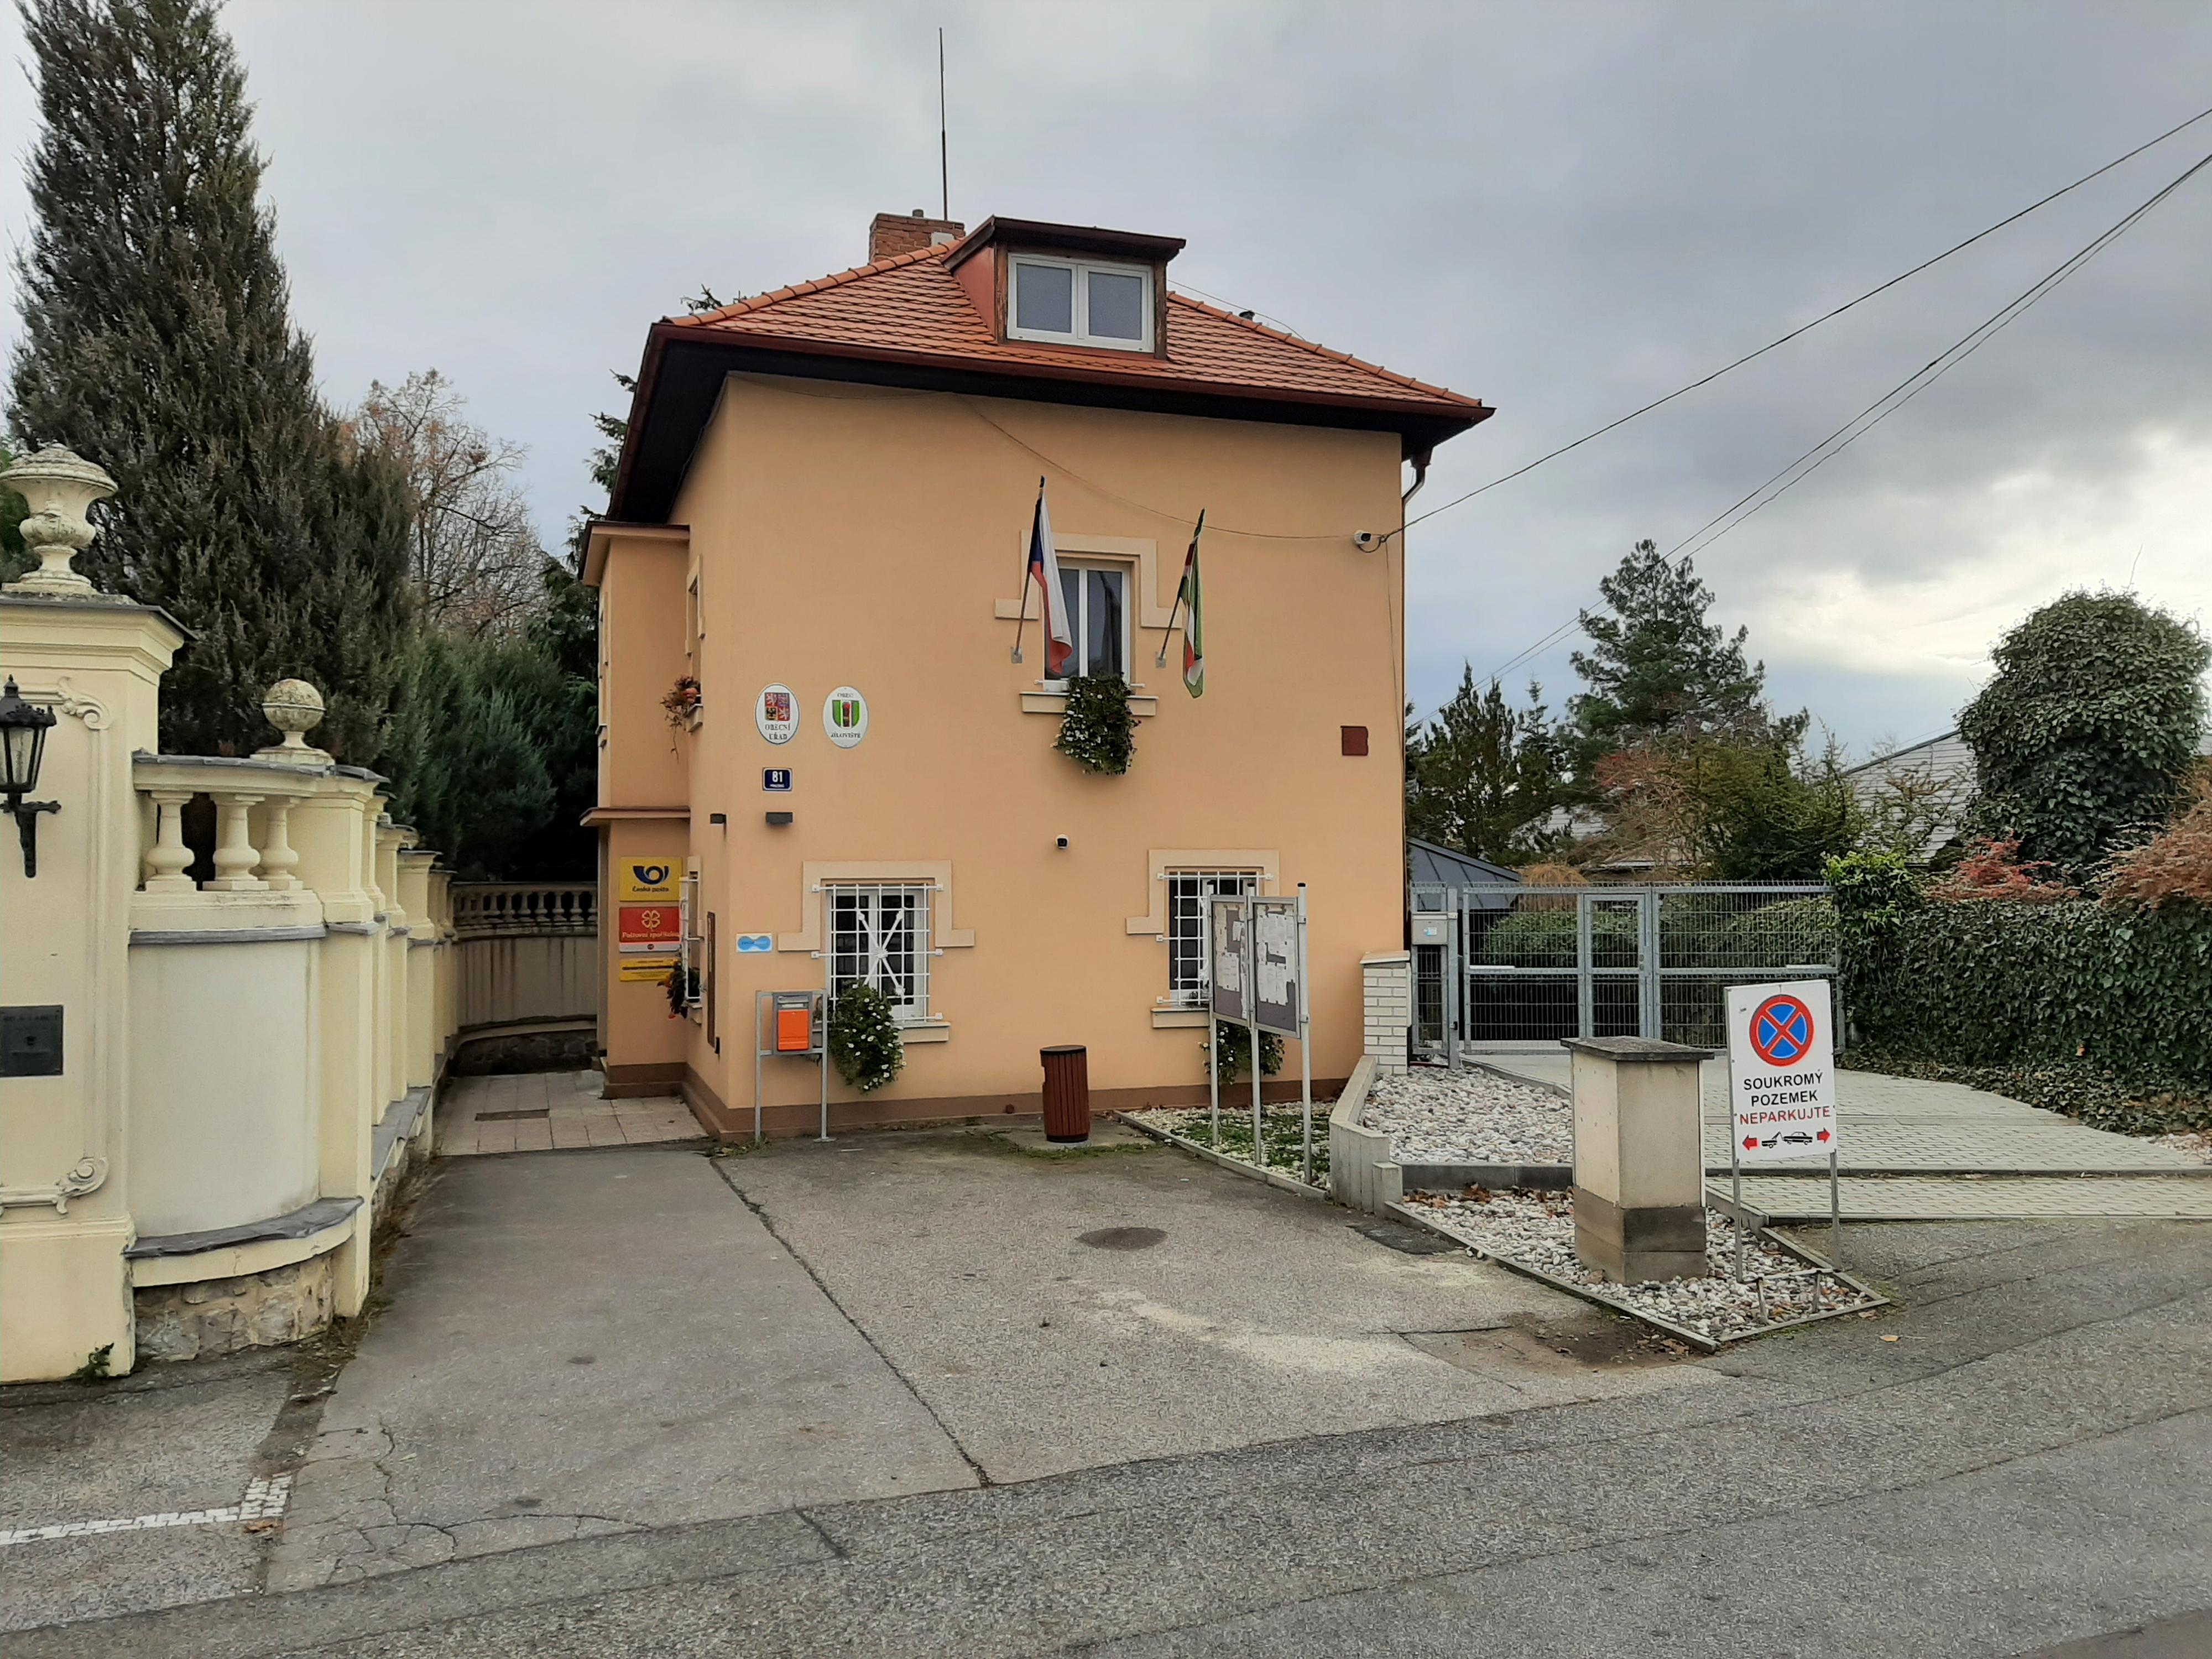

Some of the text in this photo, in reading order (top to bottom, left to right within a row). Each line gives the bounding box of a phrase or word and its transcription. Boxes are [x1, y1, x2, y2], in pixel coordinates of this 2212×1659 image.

[772, 771, 782, 782] 81
[1744, 1069, 1823, 1091] SOUKROMÝ
[1751, 1090, 1818, 1107] POZEMEK
[1740, 1106, 1830, 1125] NEPARKUJTE
